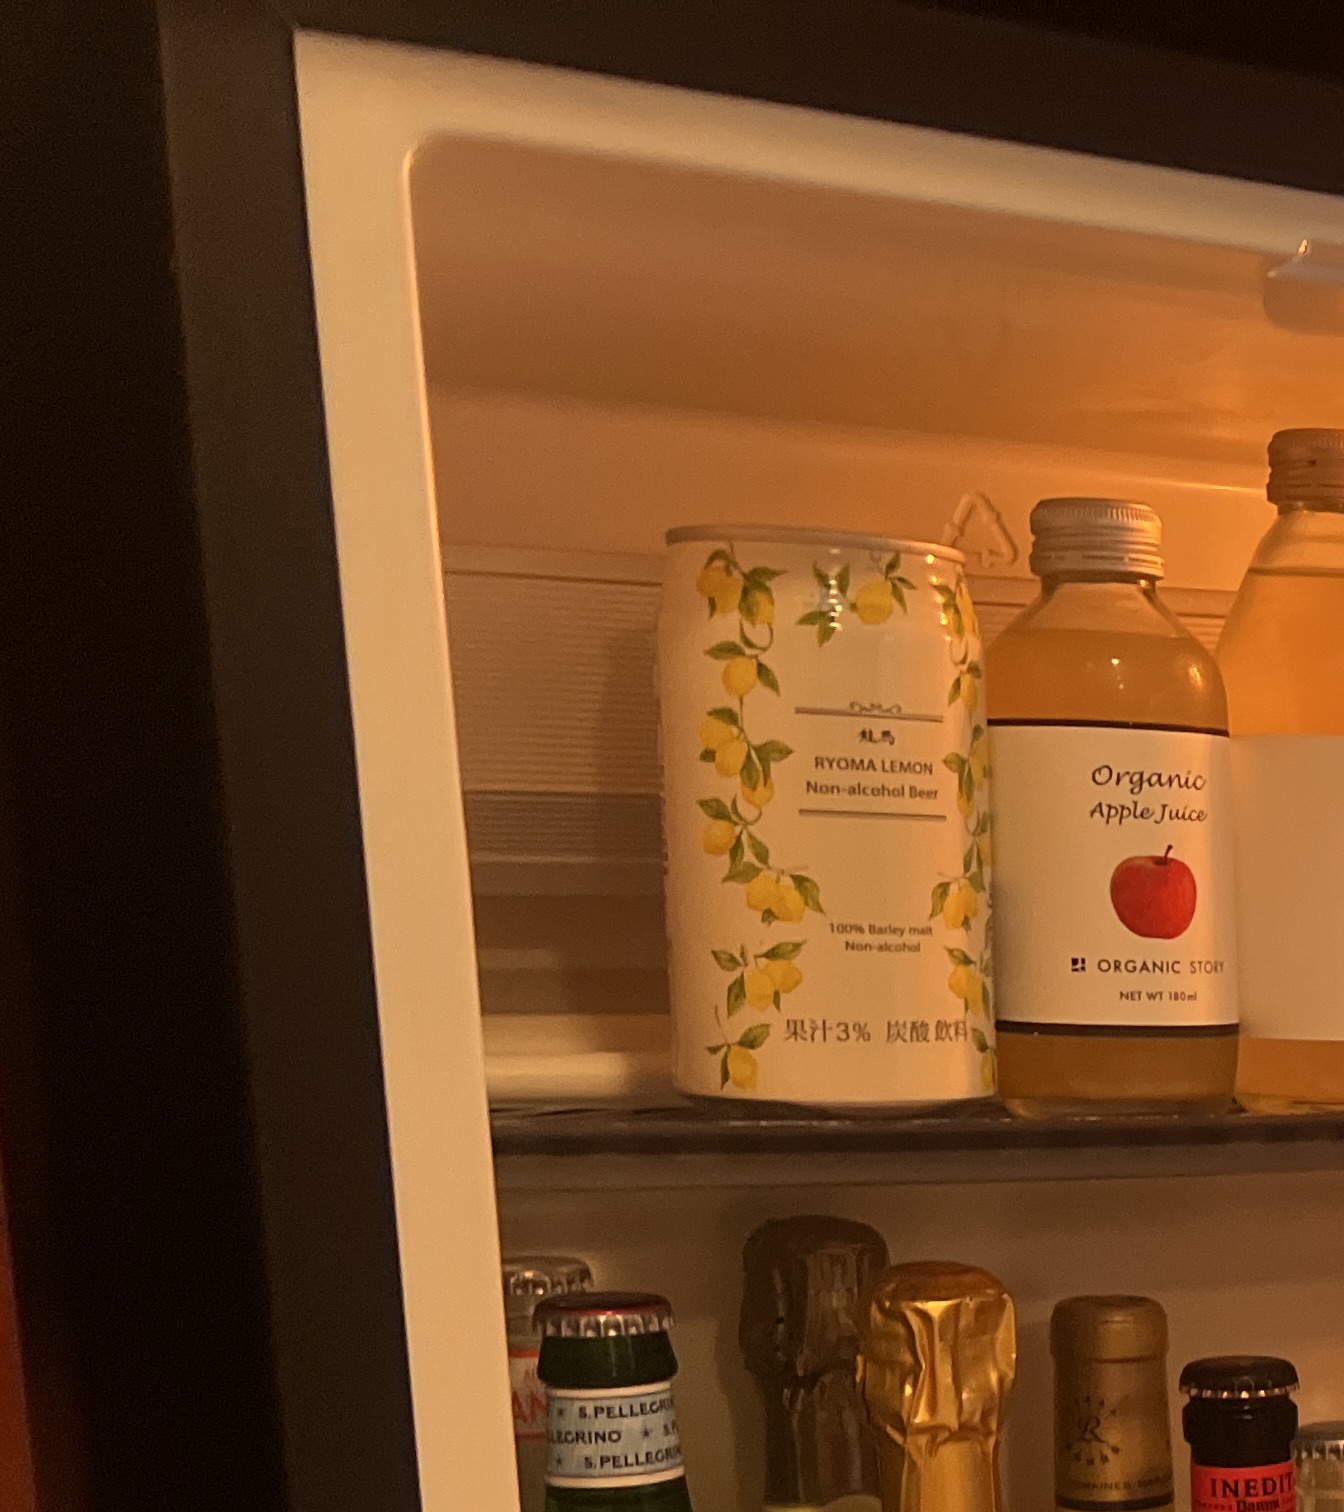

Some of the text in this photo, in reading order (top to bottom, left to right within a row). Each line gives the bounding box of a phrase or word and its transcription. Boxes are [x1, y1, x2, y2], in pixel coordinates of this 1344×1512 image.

[814, 756, 934, 776] RYOMA LEMON
[1090, 763, 1207, 795] Organic
[805, 780, 939, 800] Non-alcohol Beer
[1089, 800, 1208, 826] Apple Juice
[829, 922, 866, 935] 100%
[868, 923, 906, 938] Barley
[844, 940, 922, 953] Non-alcohol
[1096, 958, 1225, 975] ORGANIC STORY
[1119, 990, 1143, 1002] NET
[1146, 990, 1164, 1002] WT
[784, 1018, 969, 1044] 果汁3% 炭酸飲料
[1210, 1471, 1293, 1498] INEDIT
